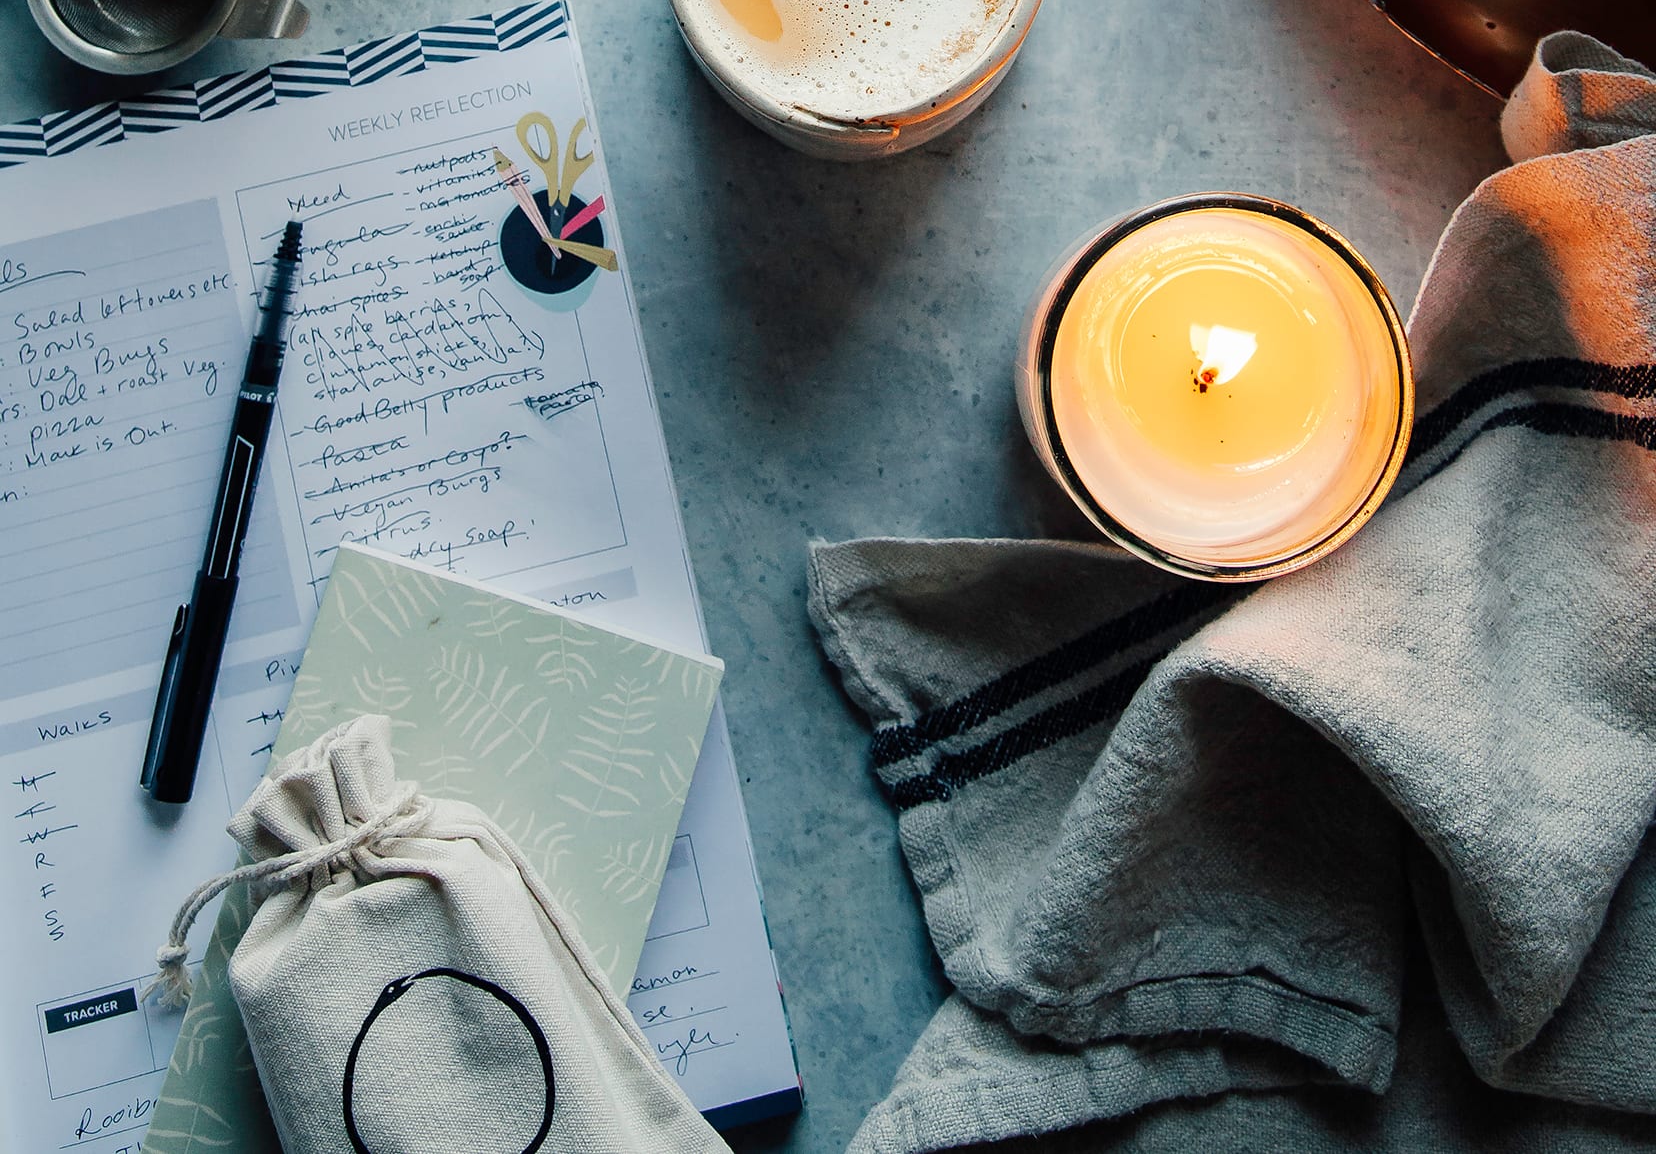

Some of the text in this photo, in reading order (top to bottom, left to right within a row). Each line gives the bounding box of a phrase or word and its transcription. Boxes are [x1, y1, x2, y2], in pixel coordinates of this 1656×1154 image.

[328, 80, 533, 142] WEEKLY REFLECTION
[416, 166, 496, 194] vitamins
[286, 183, 351, 213] Need
[300, 254, 399, 287] ish rags
[349, 286, 404, 313] spices
[14, 301, 86, 340] Salad
[19, 331, 96, 366] Bowls
[28, 363, 78, 399] Veg
[117, 367, 169, 394] roast
[312, 402, 369, 434] Good
[441, 367, 546, 414] products
[96, 434, 114, 453] is
[333, 468, 502, 528] Vegan Burgs
[34, 851, 55, 870] R
[39, 882, 57, 899] F
[44, 908, 59, 927] S
[631, 965, 698, 992] amon
[63, 999, 119, 1024] TRACKER
[74, 1097, 158, 1141] Rooib
